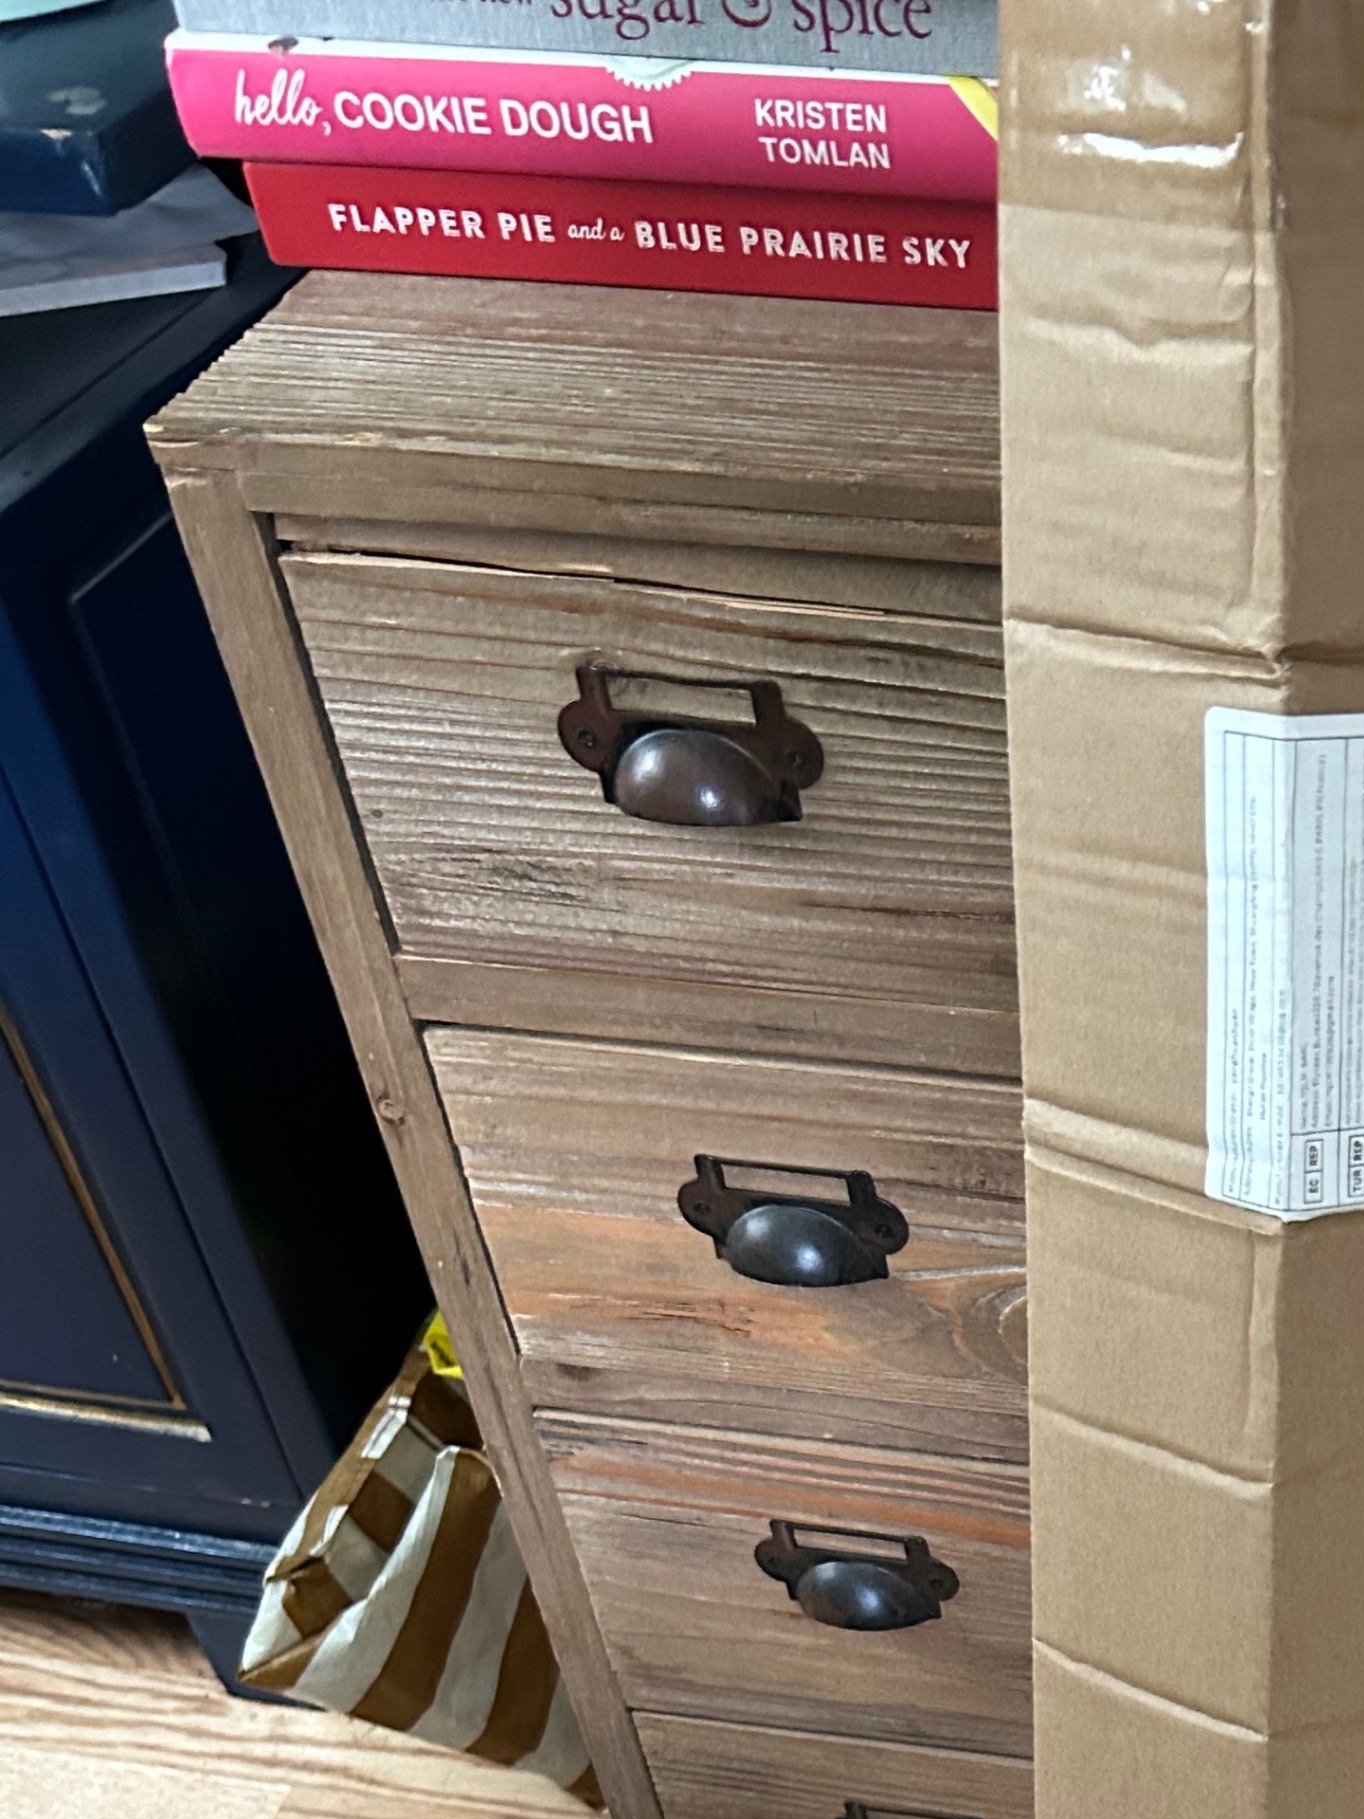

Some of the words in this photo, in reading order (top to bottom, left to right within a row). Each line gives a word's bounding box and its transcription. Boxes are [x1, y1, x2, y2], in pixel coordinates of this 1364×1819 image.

[792, 0, 932, 53] spice
[234, 68, 332, 136] hello,
[333, 90, 492, 136] COOKIE
[499, 97, 654, 144] DOUGH
[754, 98, 887, 134] KRISTEN
[758, 136, 892, 170] TOMLAN
[327, 203, 486, 240] FLAPPER
[497, 211, 556, 243] PIE
[567, 217, 607, 241] and
[609, 224, 625, 242] a
[634, 219, 725, 253] BLUE
[739, 226, 887, 263] PRAIRIE
[901, 236, 971, 269] SKY
[1308, 1145, 1319, 1167] REP
[1353, 1141, 1363, 1161] REP
[1308, 1179, 1319, 1194] EC
[1352, 1170, 1362, 1192] TUR
